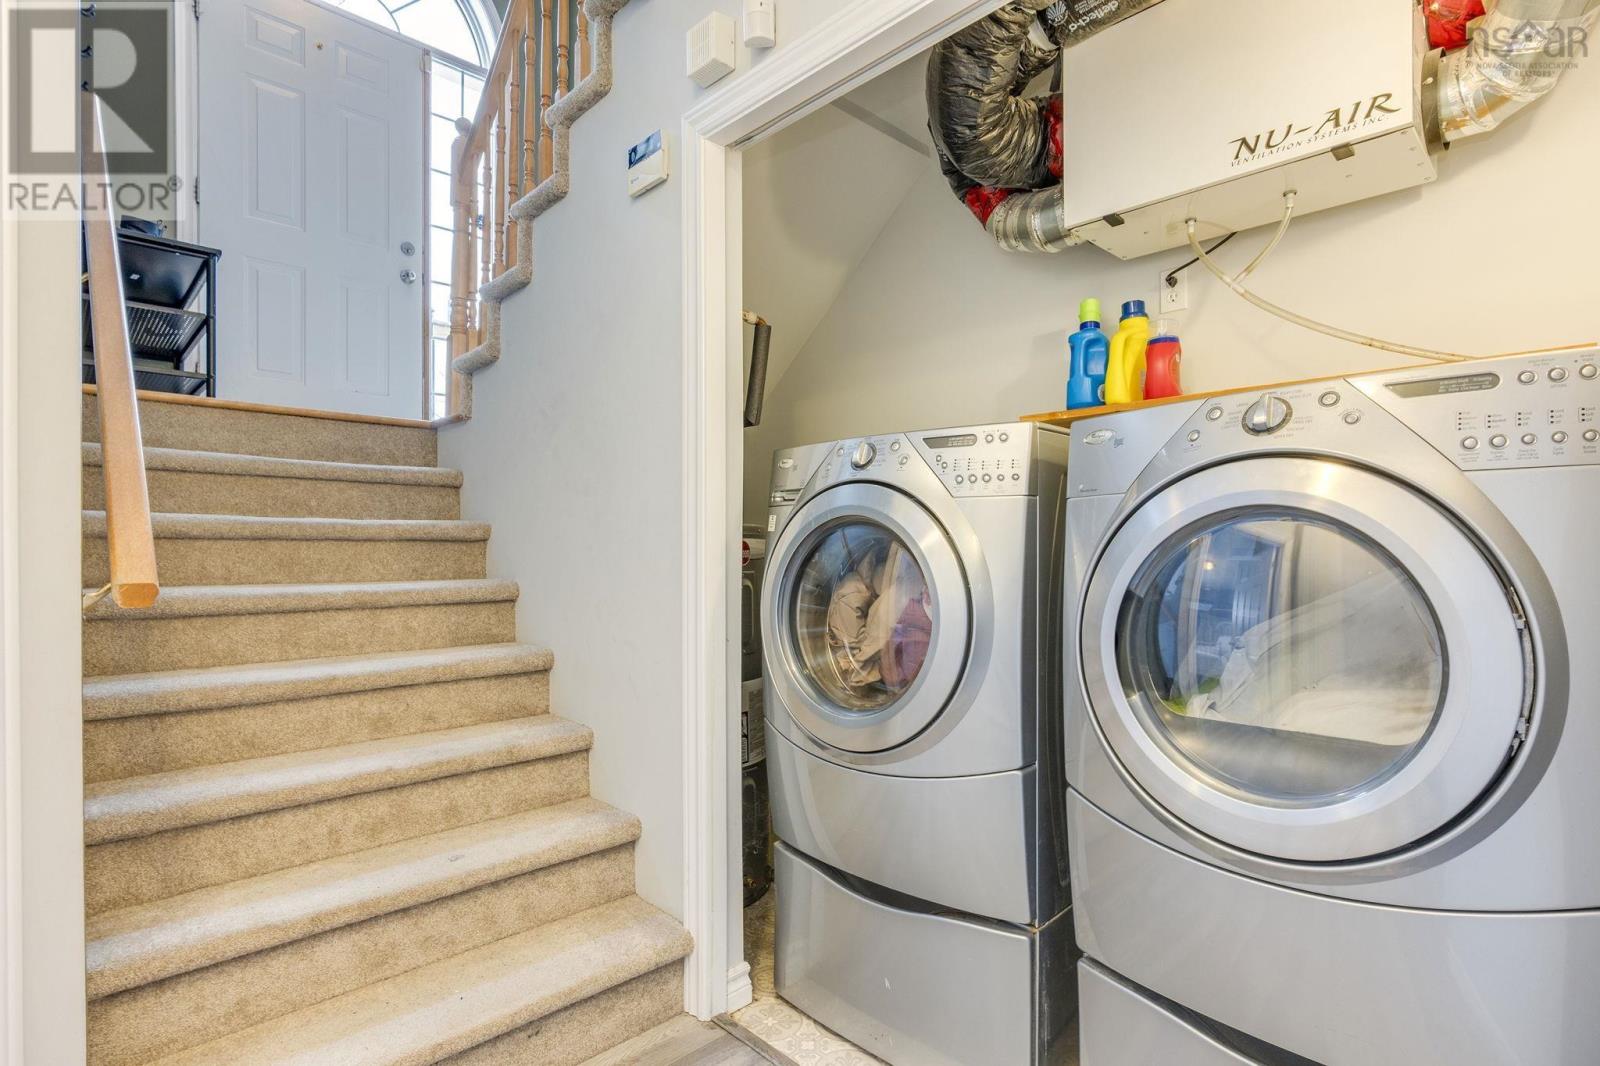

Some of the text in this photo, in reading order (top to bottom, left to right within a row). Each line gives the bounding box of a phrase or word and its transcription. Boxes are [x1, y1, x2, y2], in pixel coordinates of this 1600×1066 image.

[1228, 93, 1401, 160] NU-AIR
[1230, 114, 1389, 168] VENTILATION SYSTEMS INC.
